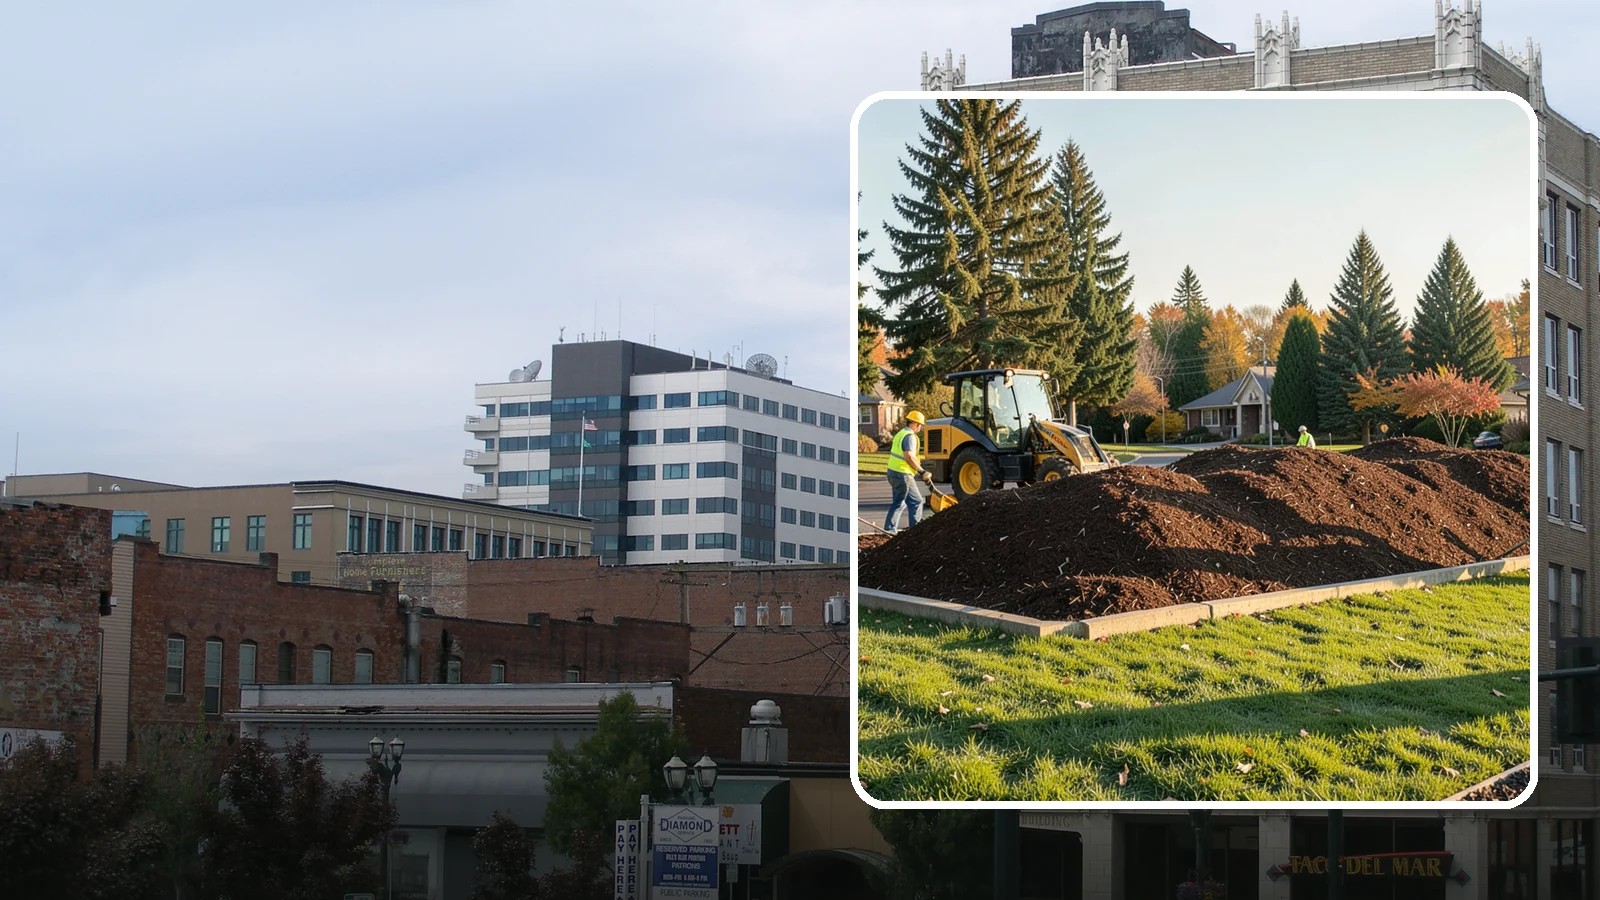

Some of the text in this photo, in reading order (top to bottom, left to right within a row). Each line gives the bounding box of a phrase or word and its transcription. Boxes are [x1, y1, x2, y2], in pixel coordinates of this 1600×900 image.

[343, 566, 427, 577] Home Furnishers
[660, 818, 713, 833] DIAMOND
[1021, 815, 1070, 828] BUILDING
[656, 845, 716, 854] RESERVED PARKING
[616, 825, 625, 894] PAY HERE
[628, 824, 637, 894] PAY HERE
[721, 851, 739, 863] Soup
[671, 862, 701, 870] PATRONS
[1346, 856, 1385, 875] DEL
[1391, 857, 1443, 877] MAR
[660, 888, 710, 898] PUBLIC PARKING
